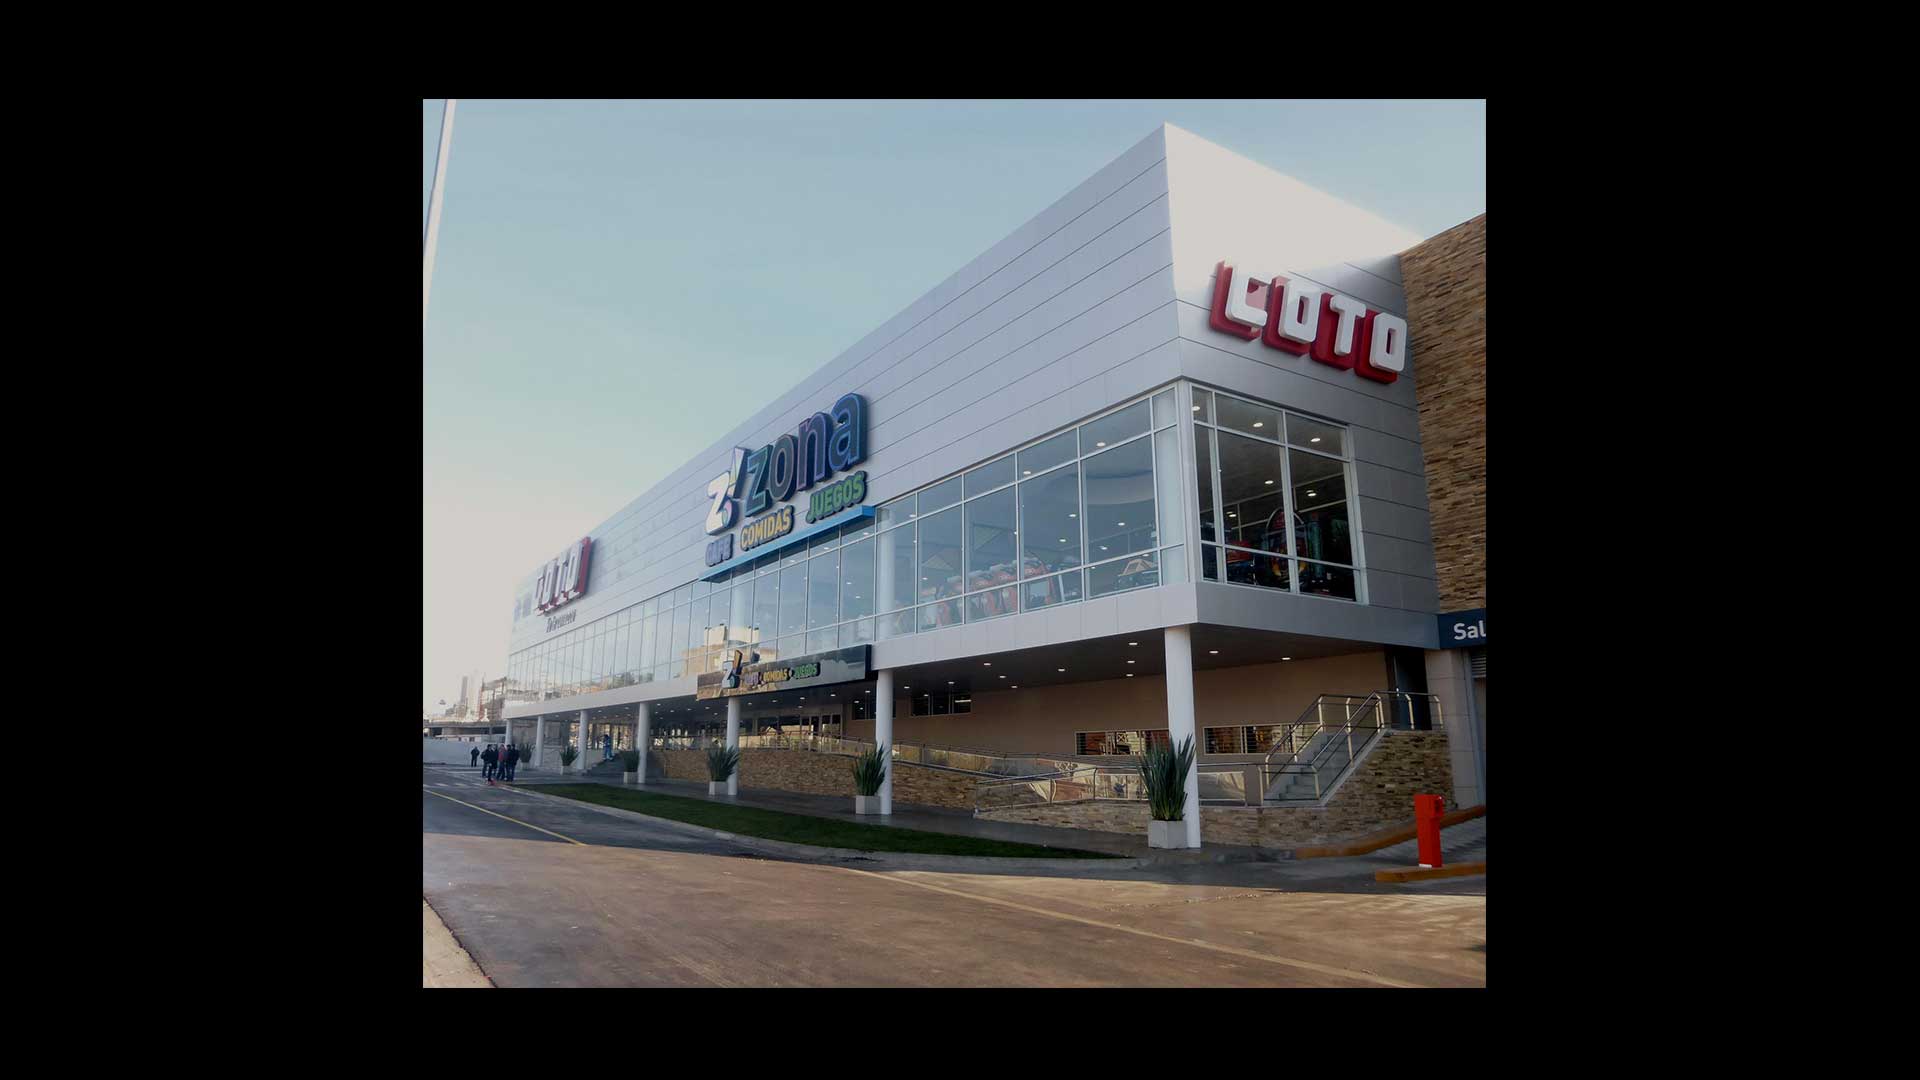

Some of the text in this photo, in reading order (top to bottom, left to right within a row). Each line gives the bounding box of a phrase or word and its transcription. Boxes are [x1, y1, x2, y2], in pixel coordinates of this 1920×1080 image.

[1209, 257, 1407, 384] COTO
[745, 392, 868, 517] zona
[740, 505, 795, 551] COMIDAS
[806, 471, 867, 523] JUEGOS
[1453, 620, 1486, 640] Sal
